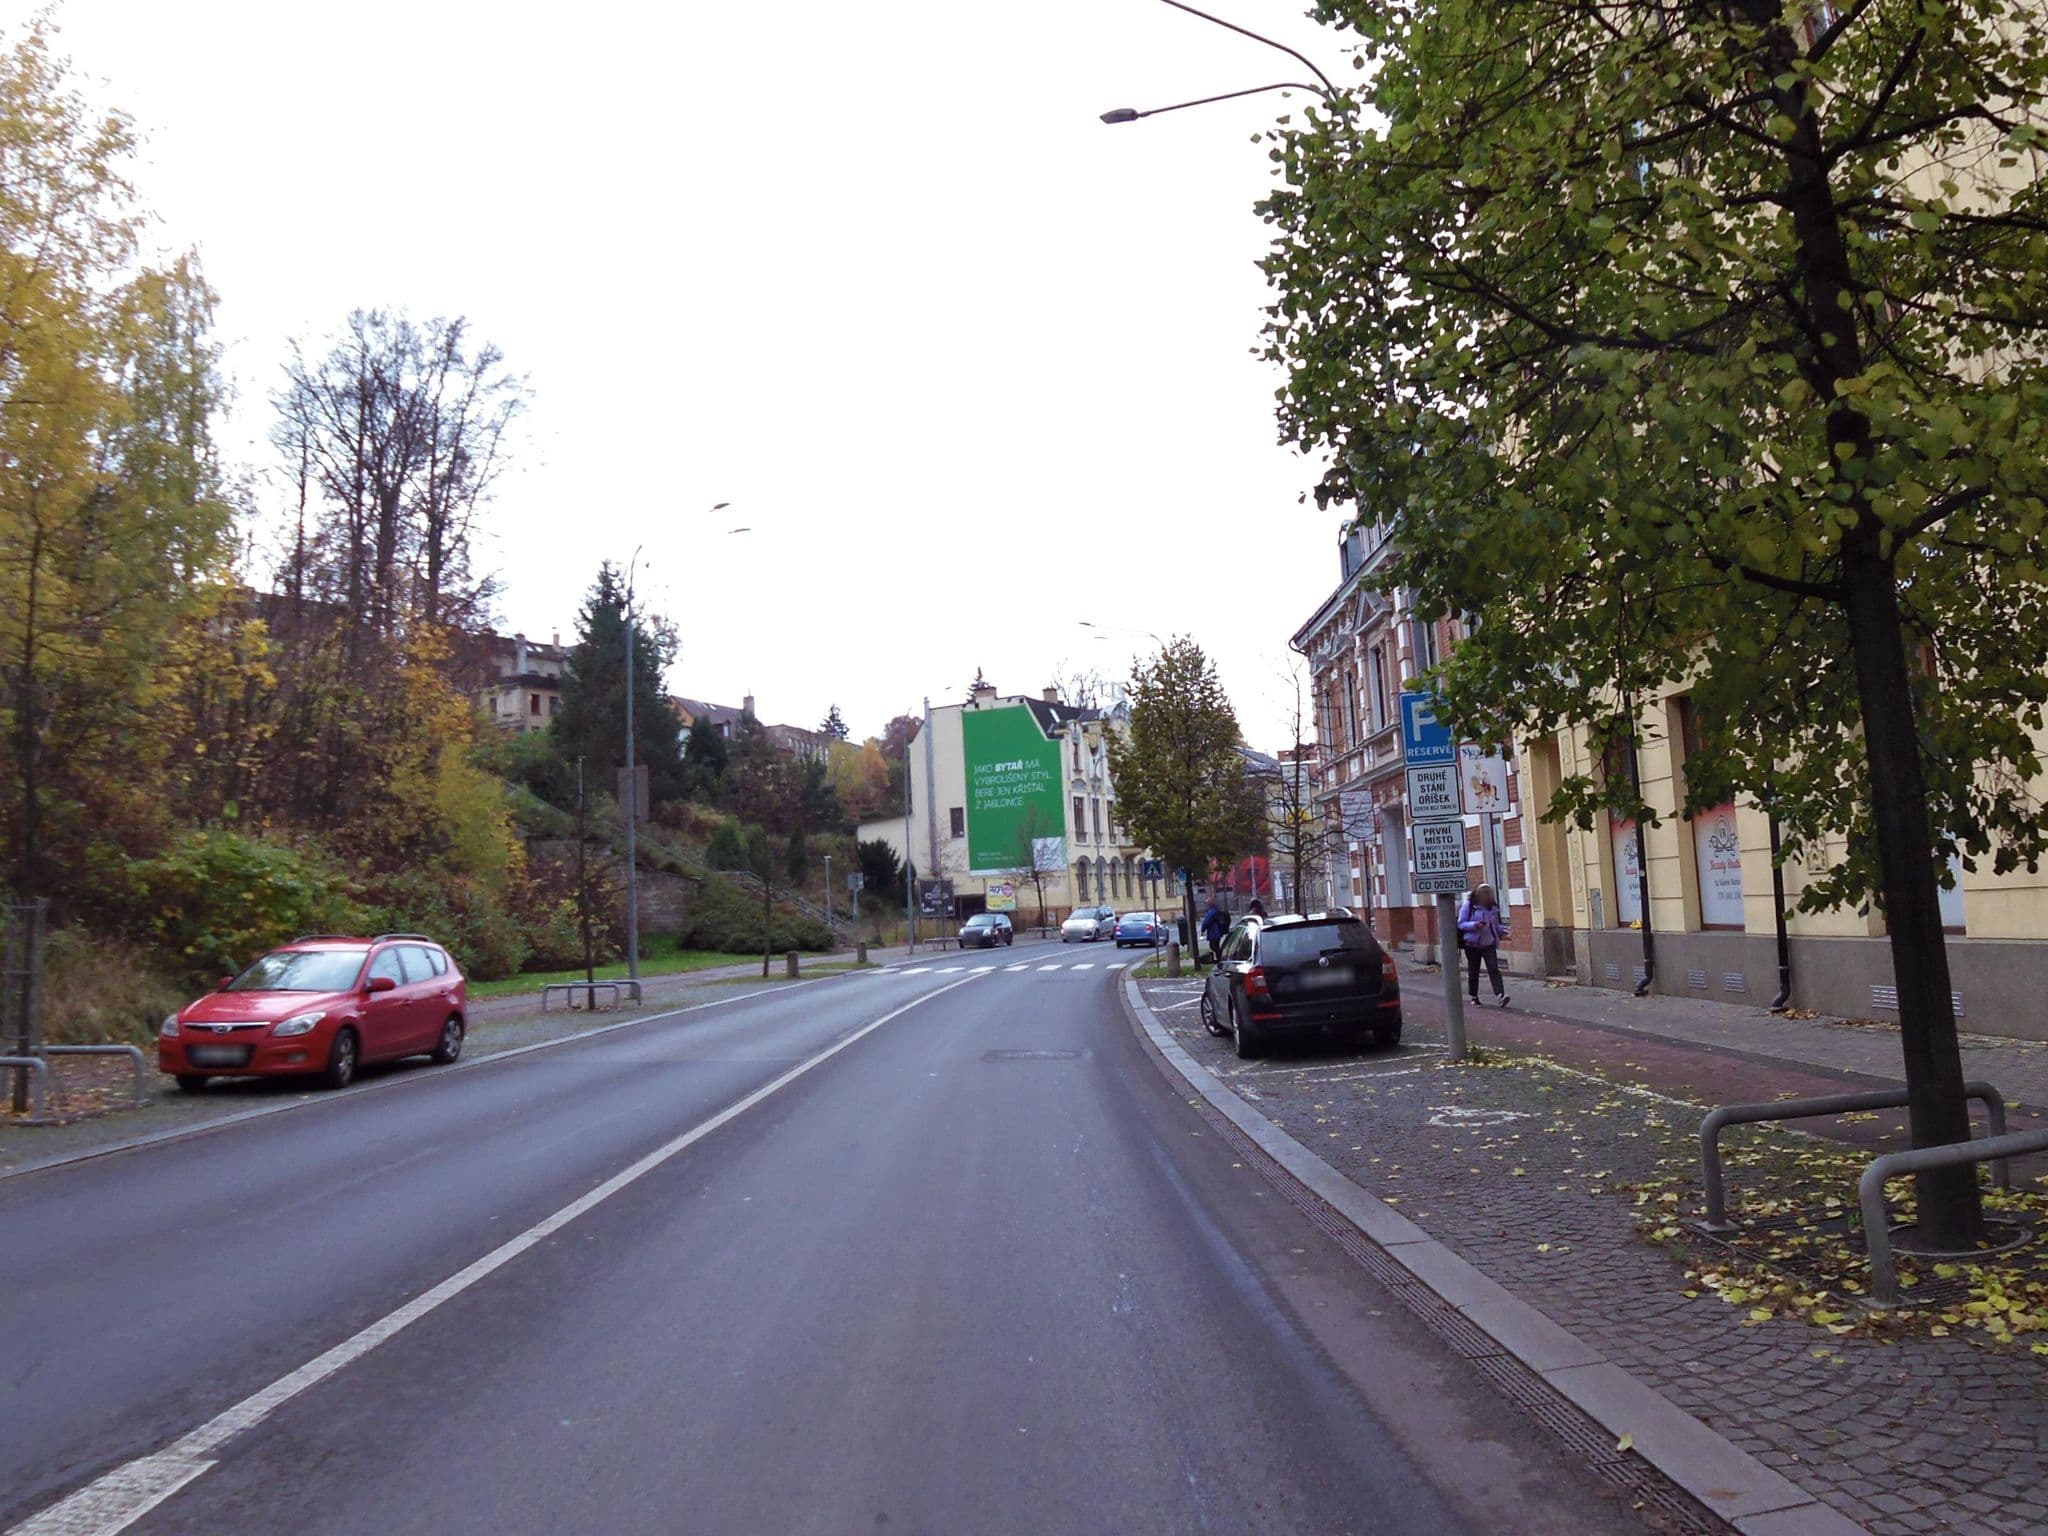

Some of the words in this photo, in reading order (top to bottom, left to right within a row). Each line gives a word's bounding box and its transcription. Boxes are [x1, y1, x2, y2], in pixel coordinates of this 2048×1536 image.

[995, 760, 1023, 771] BYTAŘ
[1418, 771, 1447, 782] DRUHÉ
[1420, 782, 1446, 793] STÁNÍ
[1424, 826, 1451, 836] PRVNÍ
[1440, 851, 1460, 859] 1144
[1421, 861, 1437, 869] 5L9
[1440, 860, 1460, 868] 8540
